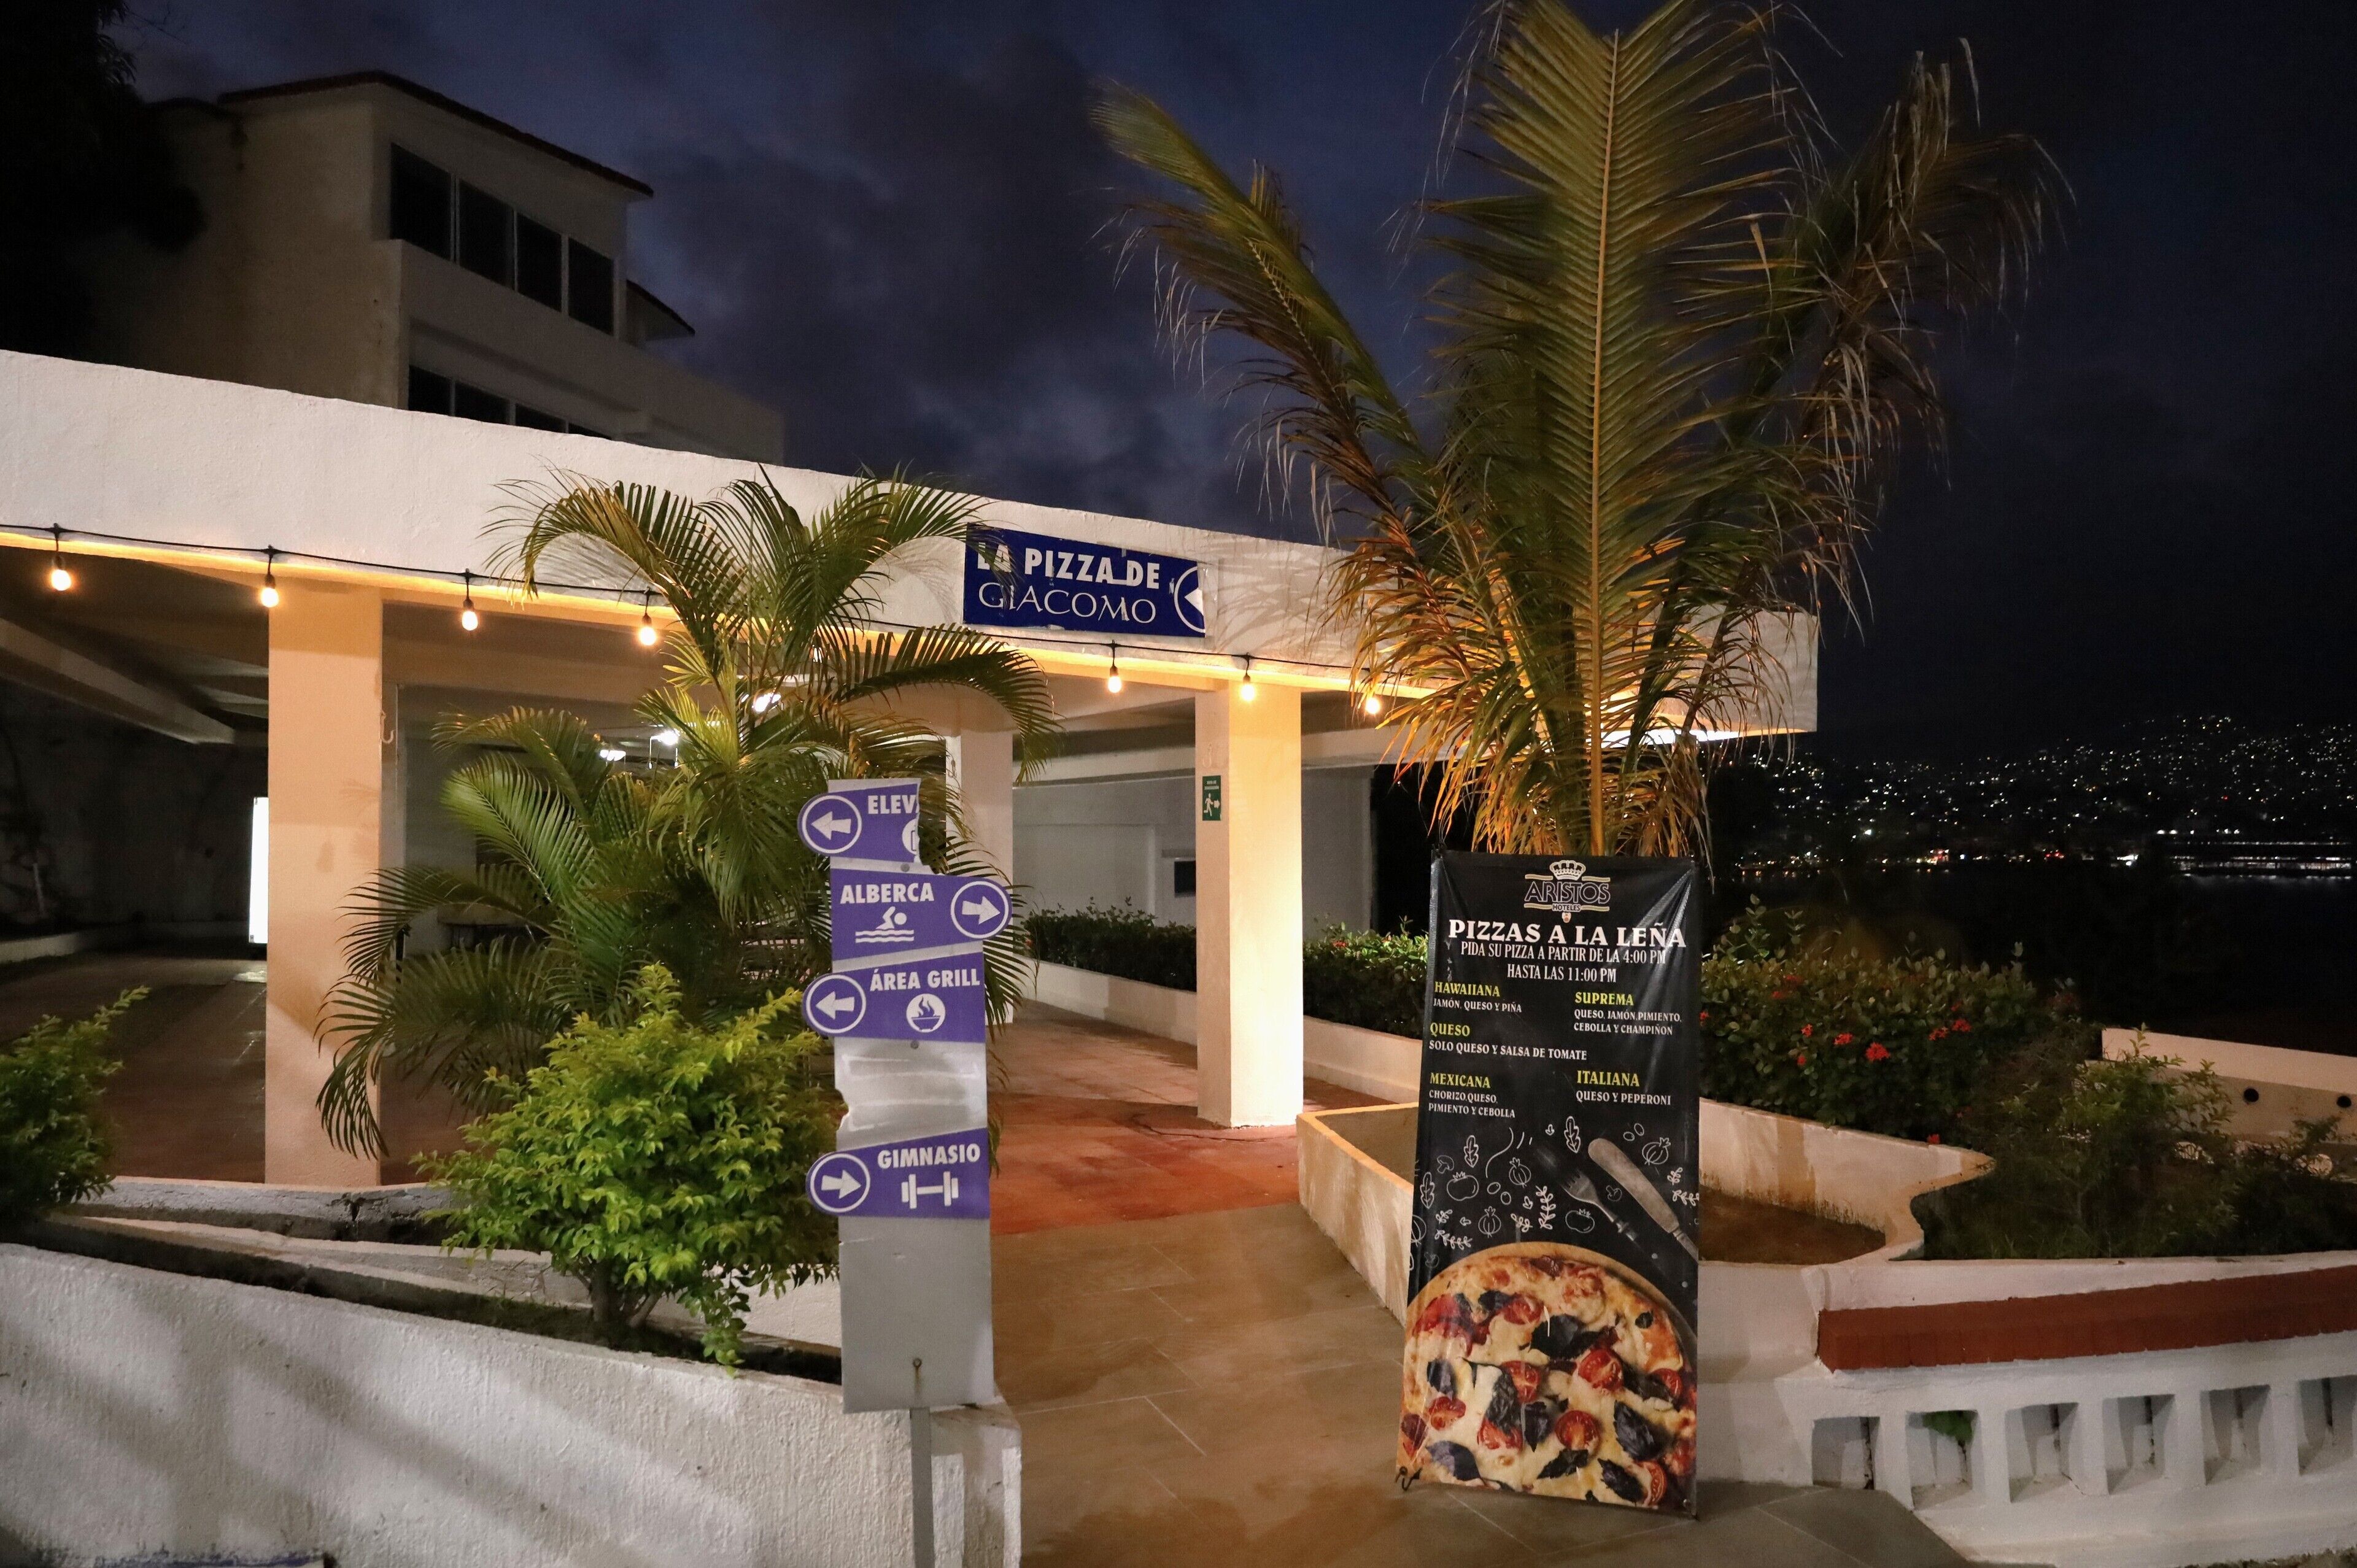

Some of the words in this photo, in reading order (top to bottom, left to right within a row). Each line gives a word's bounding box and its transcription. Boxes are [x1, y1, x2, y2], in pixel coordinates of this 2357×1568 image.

[1024, 548, 1114, 584] PIZZA
[1126, 560, 1159, 589] DE
[978, 582, 1156, 624] GIACOMO
[868, 794, 919, 814] ELEV
[840, 882, 935, 905] ALBERCA
[1524, 881, 1611, 904] ARISTOS
[1552, 903, 1581, 912] HOTELES
[1449, 919, 1541, 943] PIZZAS
[1547, 925, 1566, 944] A
[1574, 925, 1608, 946] LA
[1617, 922, 1686, 948] LEÑA
[1461, 941, 1485, 956] PIDA
[1488, 943, 1502, 957] SU
[1504, 944, 1535, 959] PIZZA
[1538, 946, 1545, 960] A
[1548, 946, 1586, 962] PARTIR
[1589, 948, 1603, 962] DE
[1606, 948, 1620, 963] LA
[1623, 949, 1647, 964] 4:00
[1650, 950, 1666, 964] PM
[869, 968, 921, 992] ÁREA
[927, 968, 980, 987] GRILL
[1507, 964, 1541, 979] HASTA
[1544, 965, 1565, 980] LAS
[1568, 967, 1597, 982] 11:00
[1600, 968, 1617, 983] PM
[1434, 981, 1500, 997] HAWAIIANA
[1464, 1000, 1493, 1011] QUESO
[1494, 1002, 1501, 1011] Y
[1501, 1001, 1522, 1013] PIÑA
[1575, 992, 1634, 1006] SUPREMA
[1430, 1022, 1471, 1037] QUESO
[1574, 1022, 1612, 1033] CEBOLLA
[1613, 1024, 1619, 1033] Y
[1429, 1040, 1453, 1051] SOLO
[1456, 1041, 1490, 1054] QUESO
[1492, 1045, 1498, 1054] Y
[1500, 1045, 1530, 1057] SALSA
[1533, 1047, 1546, 1057] DE
[1547, 1048, 1587, 1060] TOMATE
[1430, 1072, 1491, 1089] MEXICANA
[1576, 1070, 1640, 1087] ITALIANA
[1576, 1091, 1610, 1103] QUESO
[1612, 1092, 1619, 1102] Y
[1620, 1093, 1671, 1105] PEPERONI
[1428, 1103, 1469, 1114] PIMIENTO
[1471, 1106, 1477, 1115] Y
[1478, 1106, 1515, 1118] CEBOLLA
[878, 1143, 981, 1168] GIMNASIO
